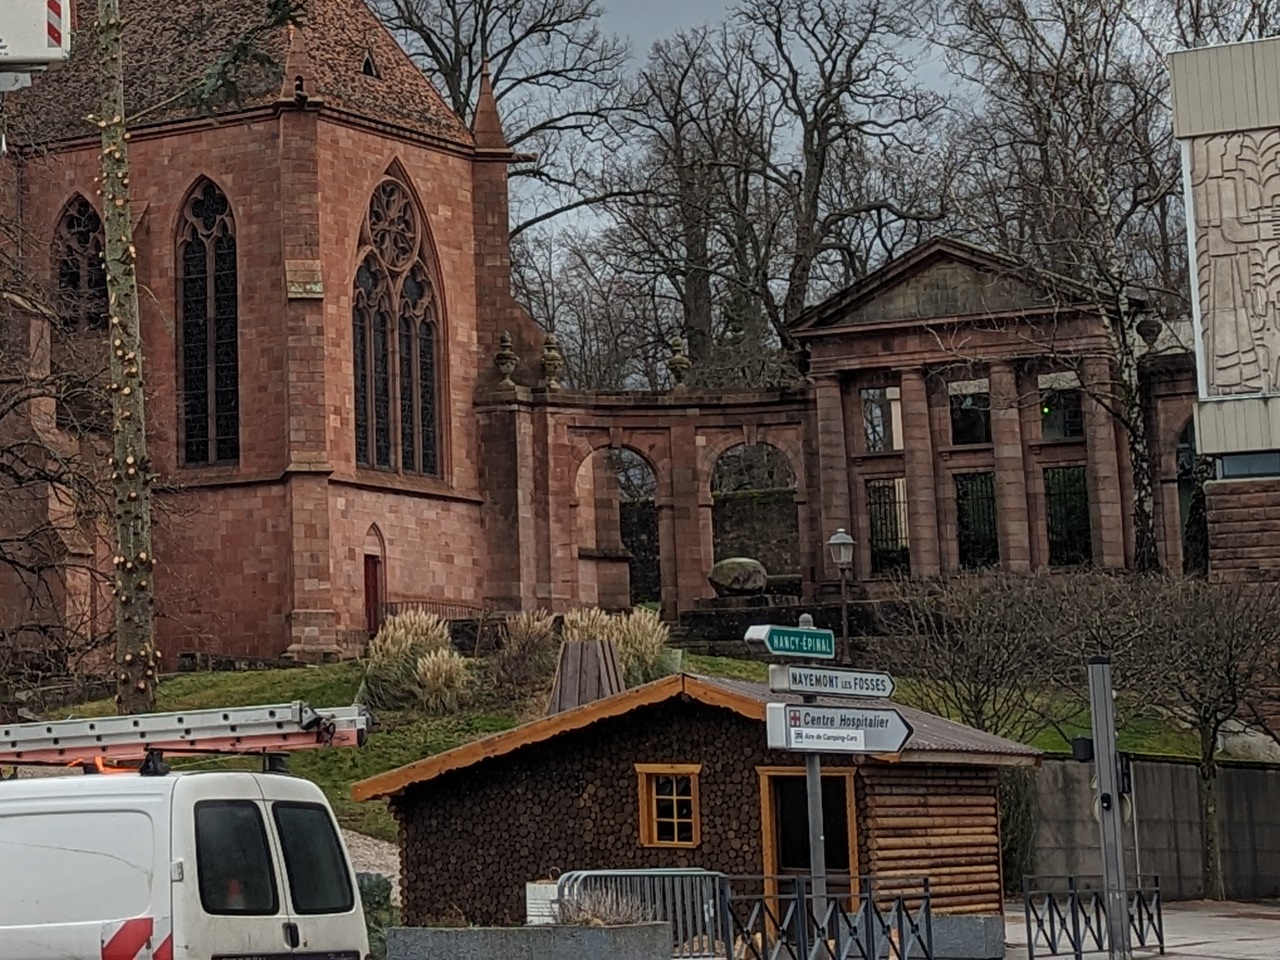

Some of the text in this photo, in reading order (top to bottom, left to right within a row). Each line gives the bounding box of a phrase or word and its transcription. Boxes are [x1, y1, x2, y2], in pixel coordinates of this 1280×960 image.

[773, 634, 831, 652] NANCY-ÉPINAL
[791, 672, 887, 692] NAYEMONT LES FOSSES
[804, 712, 889, 730] Centre Hospitalier
